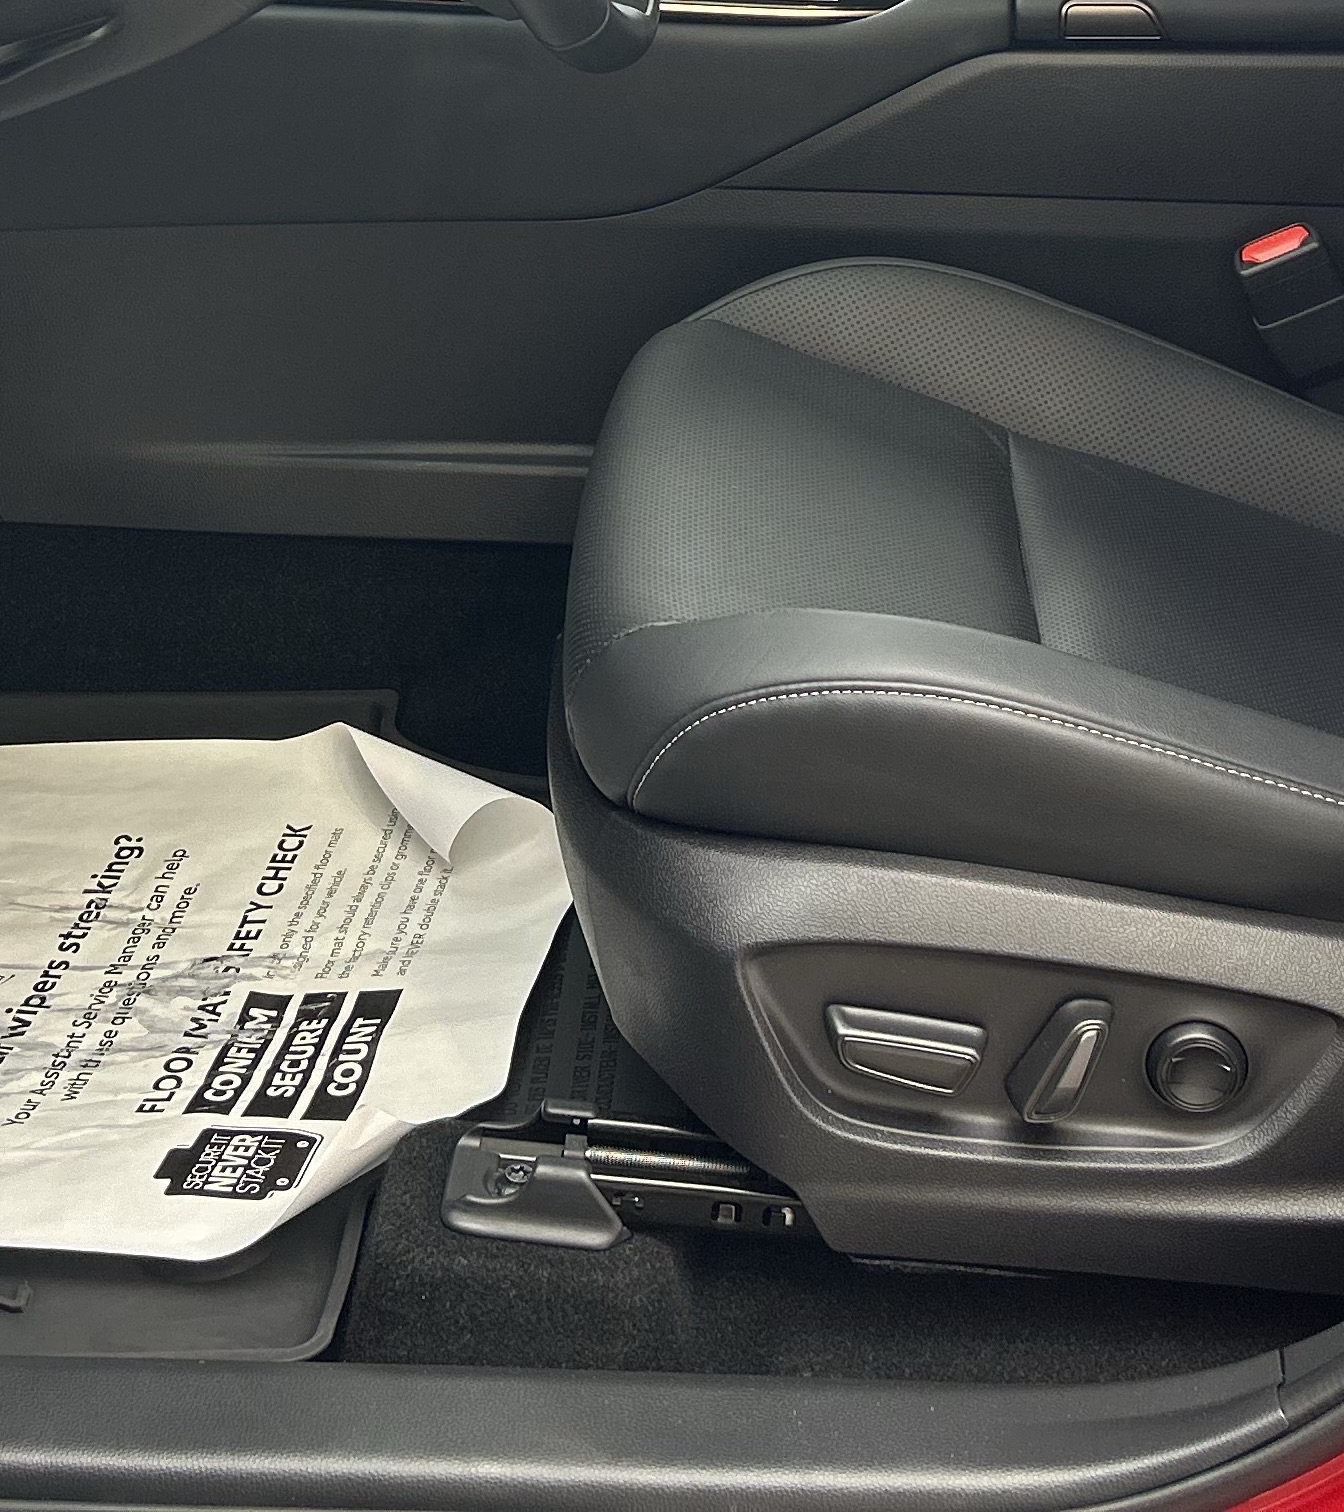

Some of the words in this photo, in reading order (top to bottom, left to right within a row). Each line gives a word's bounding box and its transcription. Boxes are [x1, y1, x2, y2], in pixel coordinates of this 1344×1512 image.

[314, 850, 333, 869] floor
[328, 828, 344, 847] mats
[155, 849, 189, 880] help
[414, 878, 427, 893] one
[418, 856, 437, 875] floor
[146, 885, 169, 910] can
[288, 912, 303, 926] the
[305, 920, 320, 932] for
[318, 900, 330, 919] your
[326, 868, 347, 898] vehicle.
[315, 960, 335, 978] Floor
[330, 937, 345, 957] mat
[338, 905, 359, 933] should
[364, 865, 378, 875] be
[372, 829, 393, 862] secured
[0, 960, 69, 1038] wipers
[60, 835, 144, 953] streaking?
[108, 916, 153, 974] Manager
[280, 929, 298, 949] only
[338, 965, 354, 978] the
[363, 892, 387, 927] retention
[380, 872, 396, 890] clips
[397, 960, 411, 975] and
[419, 899, 439, 930] double
[434, 875, 450, 896] stack
[397, 917, 409, 934] you
[61, 1072, 92, 1100] with
[80, 1030, 118, 1068] thse
[111, 955, 160, 1022] quesions
[152, 926, 175, 948] and
[168, 883, 200, 924] more.
[136, 1048, 198, 1112] FLOOR
[257, 824, 312, 895] CHECK
[73, 980, 118, 1029] Service
[30, 1033, 86, 1096] Assistant
[200, 1005, 281, 1102] CONFIRM
[264, 1016, 329, 1098] SECURE
[324, 1012, 383, 1096] COUNT
[2, 1099, 40, 1125] Your
[180, 1143, 226, 1191] SECURE
[201, 1133, 263, 1192] NEVER
[233, 1150, 281, 1195] STACK
